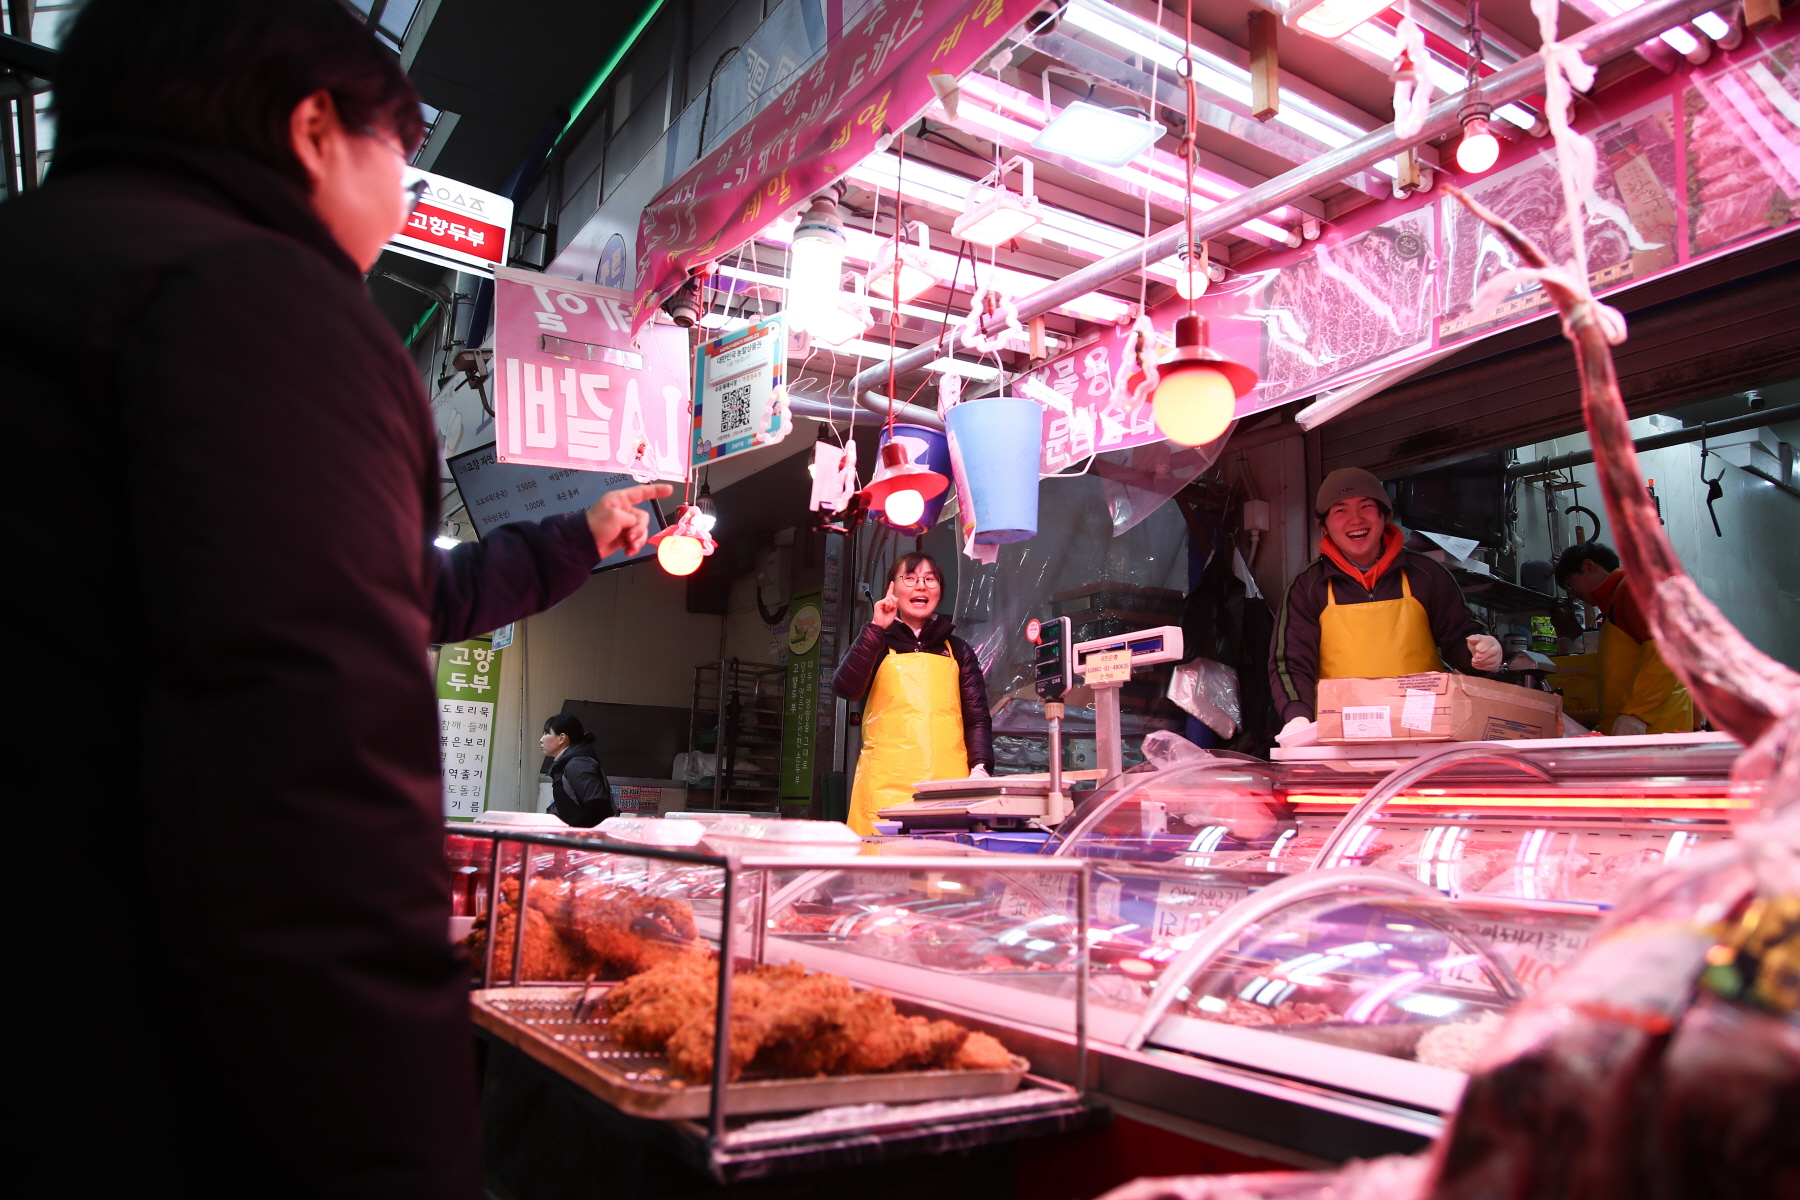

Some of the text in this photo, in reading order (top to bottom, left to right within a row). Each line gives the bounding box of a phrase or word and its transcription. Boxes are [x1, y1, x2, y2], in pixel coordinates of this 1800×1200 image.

[783, 52, 831, 115] 양념
[717, 123, 756, 175] 양념
[742, 167, 791, 223] 세일
[407, 210, 485, 248] 고향두부
[467, 459, 480, 472] 고향
[516, 479, 538, 493] 2,500원
[525, 499, 546, 512] 3,000원
[448, 646, 494, 673] 고향
[446, 672, 491, 693] 두부
[791, 663, 799, 713] 고향두부
[442, 704, 489, 718] 도토리묵
[442, 785, 481, 798] 도돌김
